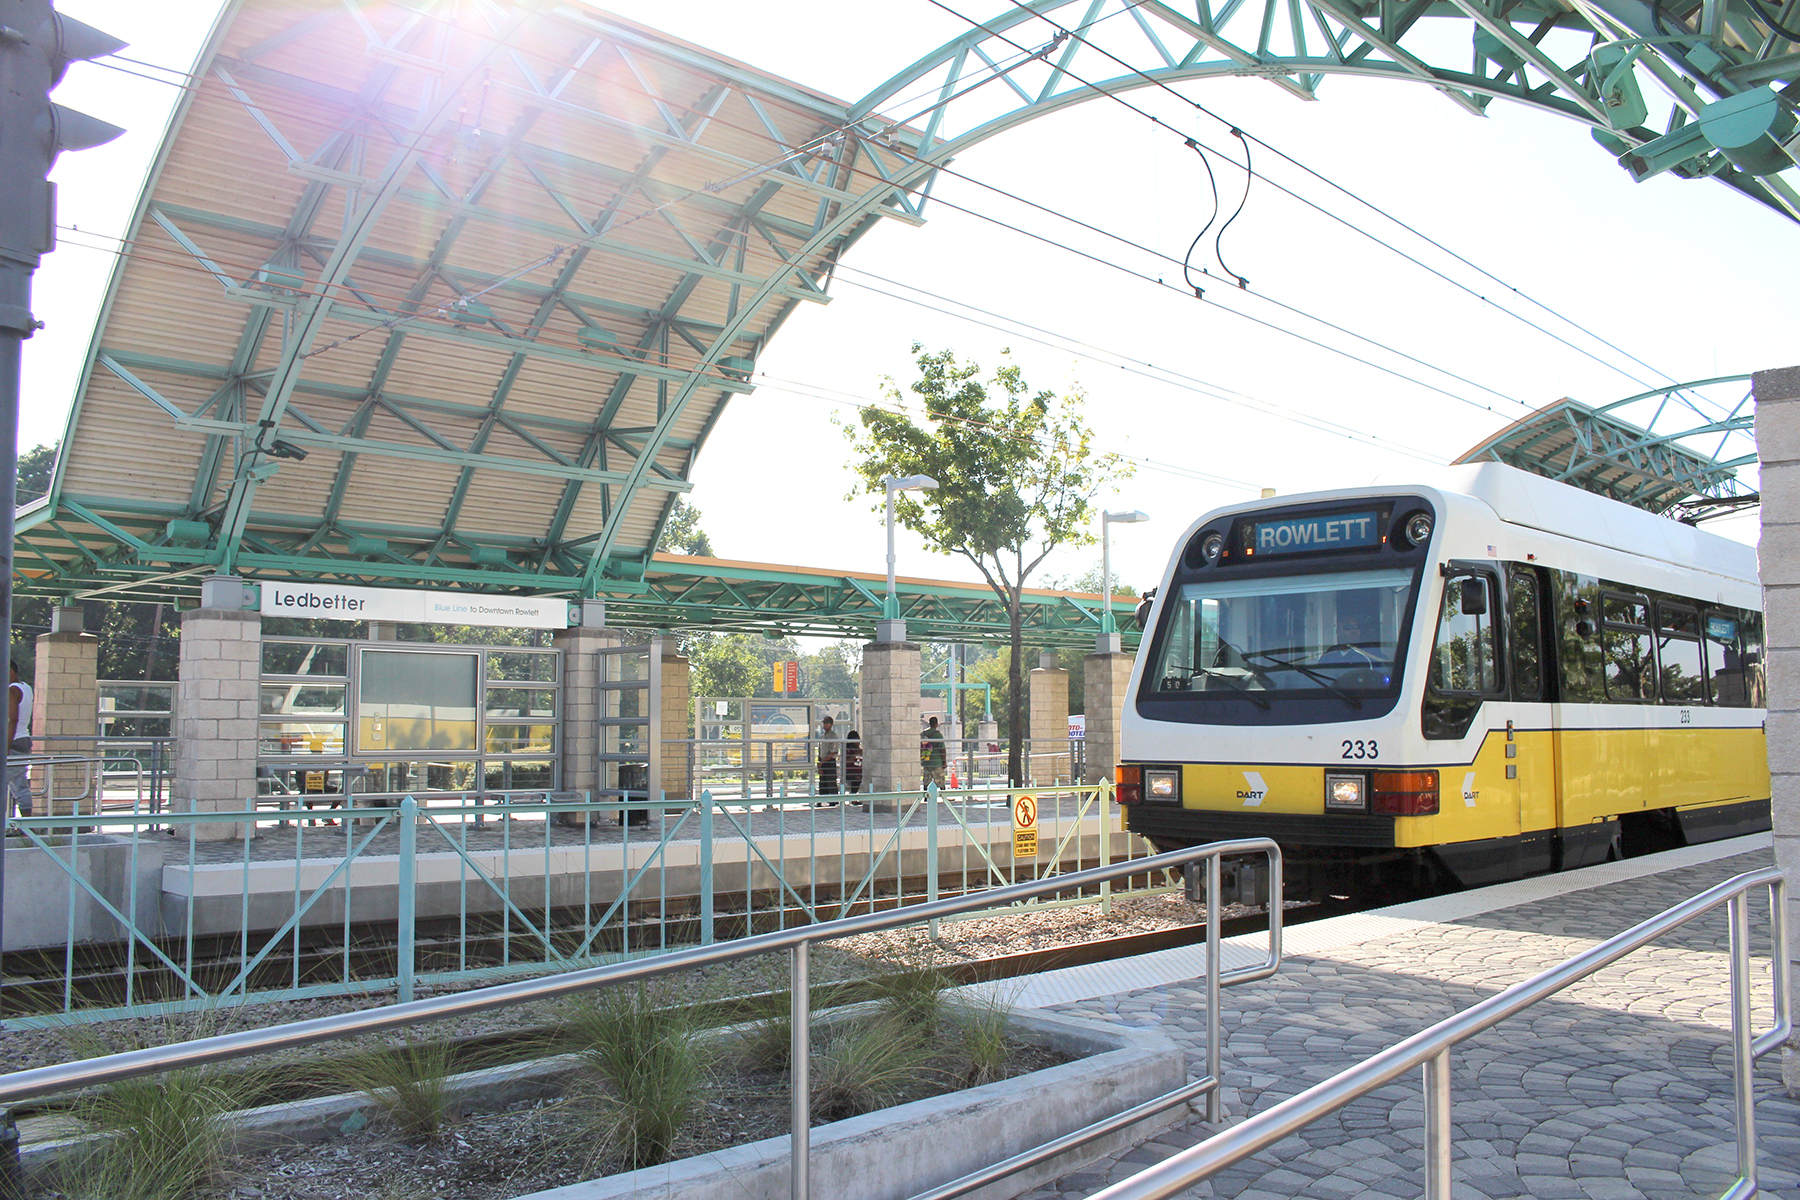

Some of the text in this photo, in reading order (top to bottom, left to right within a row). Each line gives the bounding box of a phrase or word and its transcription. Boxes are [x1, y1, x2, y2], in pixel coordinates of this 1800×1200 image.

[1261, 518, 1370, 548] ROWLETT
[275, 590, 365, 611] Ledbetter
[434, 603, 539, 616] Blue Line to Downtown Rowlett
[1341, 740, 1379, 759] 233
[1236, 791, 1264, 799] DART
[1463, 791, 1480, 800] DART
